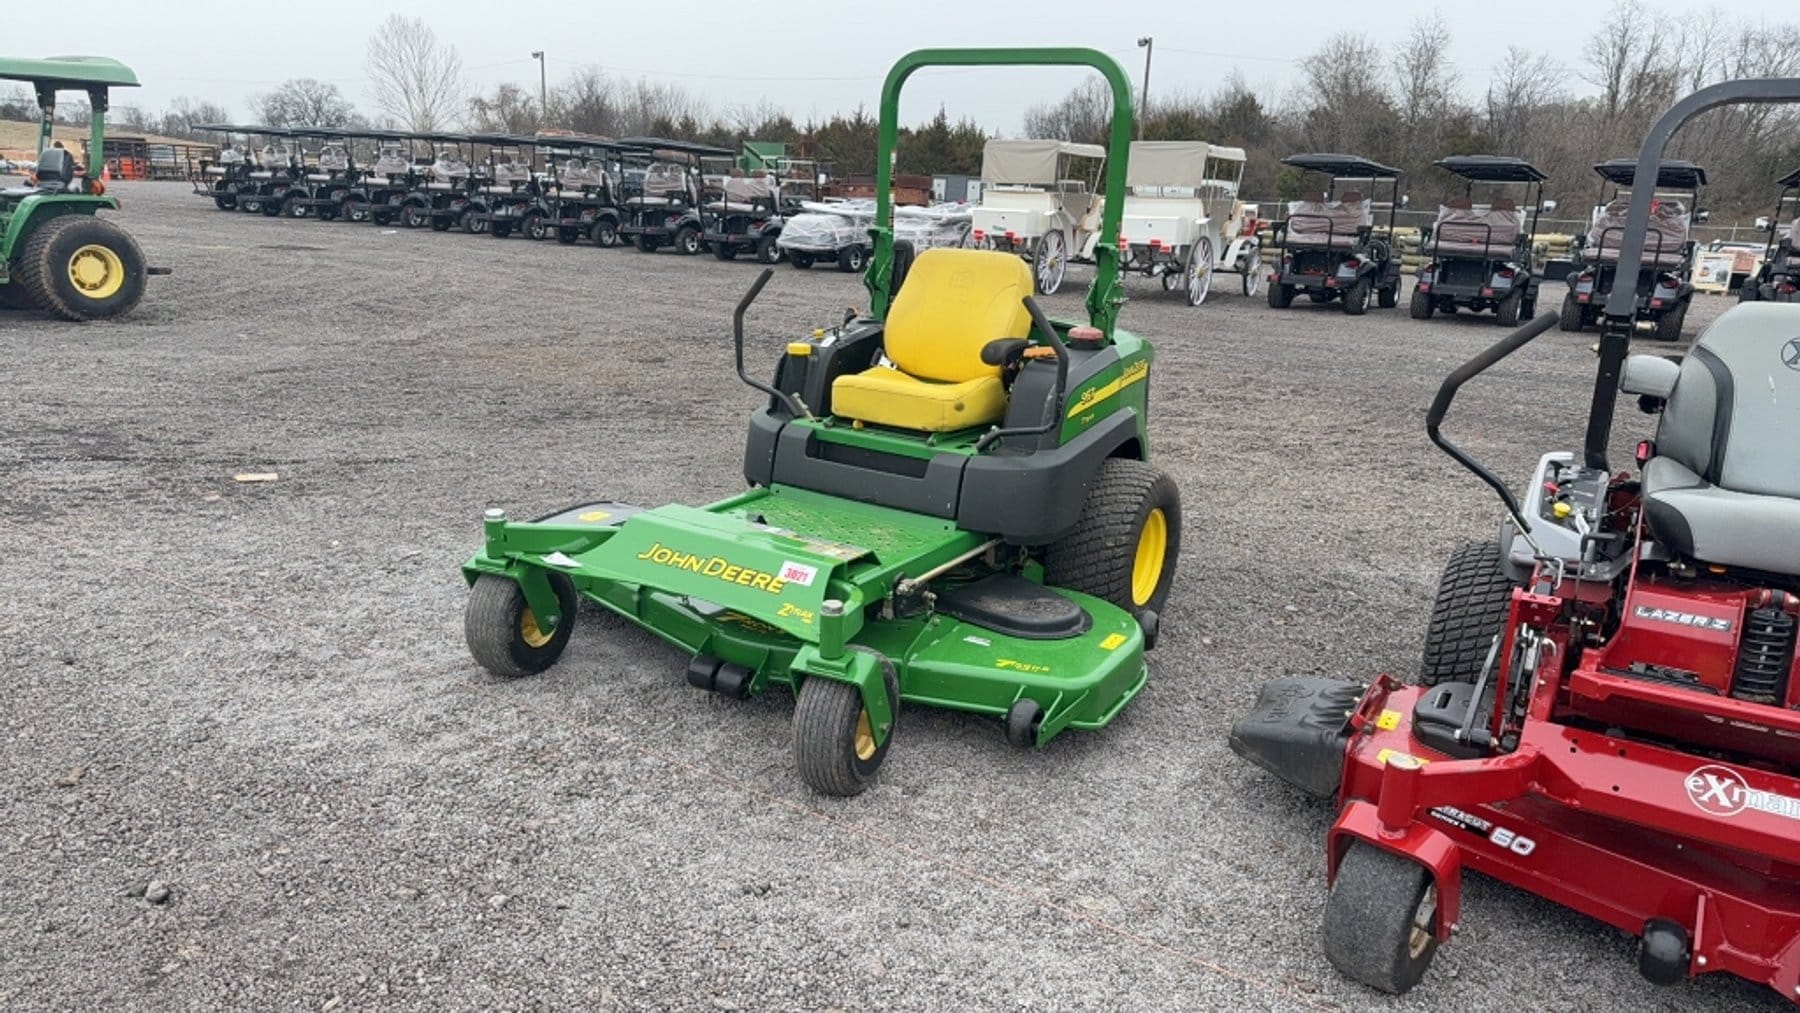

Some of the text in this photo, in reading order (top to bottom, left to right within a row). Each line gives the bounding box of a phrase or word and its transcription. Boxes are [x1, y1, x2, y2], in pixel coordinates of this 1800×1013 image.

[638, 543, 788, 594] JOHN DEERE
[1489, 826, 1536, 856] 60
